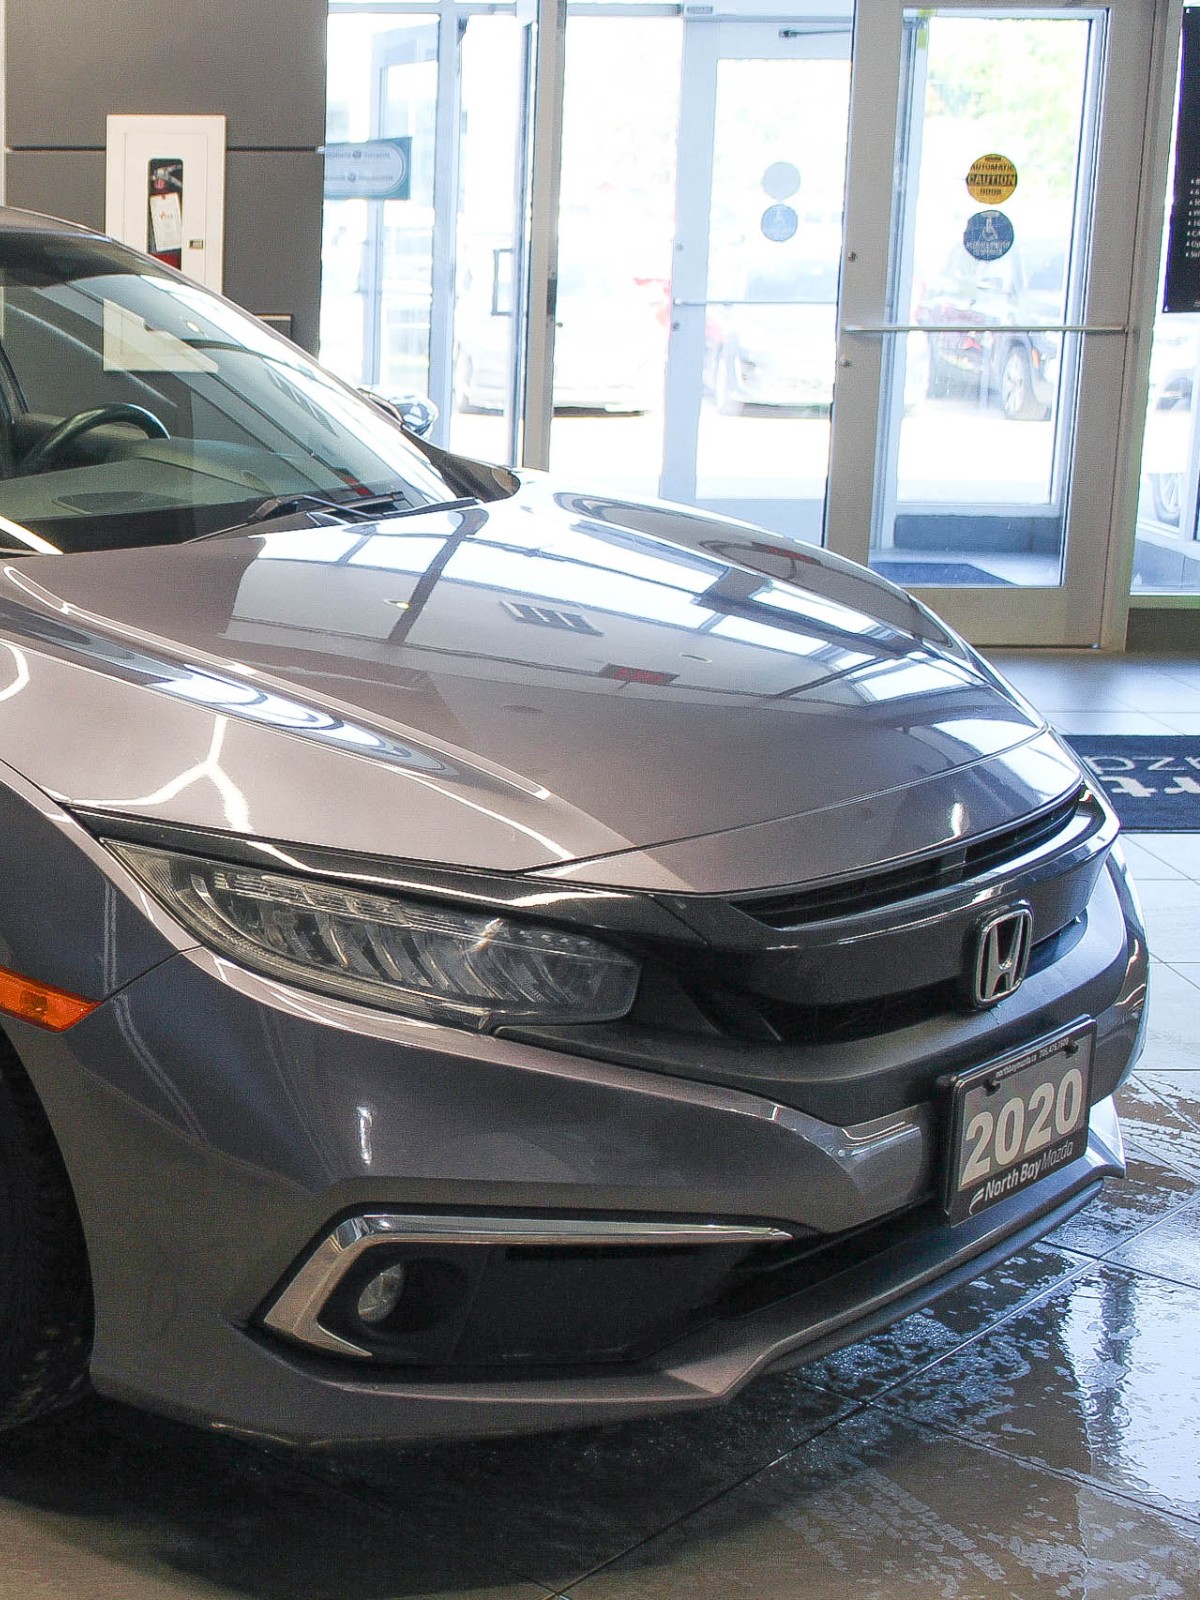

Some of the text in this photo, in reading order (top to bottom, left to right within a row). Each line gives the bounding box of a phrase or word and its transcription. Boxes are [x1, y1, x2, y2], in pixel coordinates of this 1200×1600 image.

[968, 174, 1015, 186] CAUTION
[960, 1068, 1082, 1187] 2020
[984, 1140, 1074, 1201] North Bay Mazda
